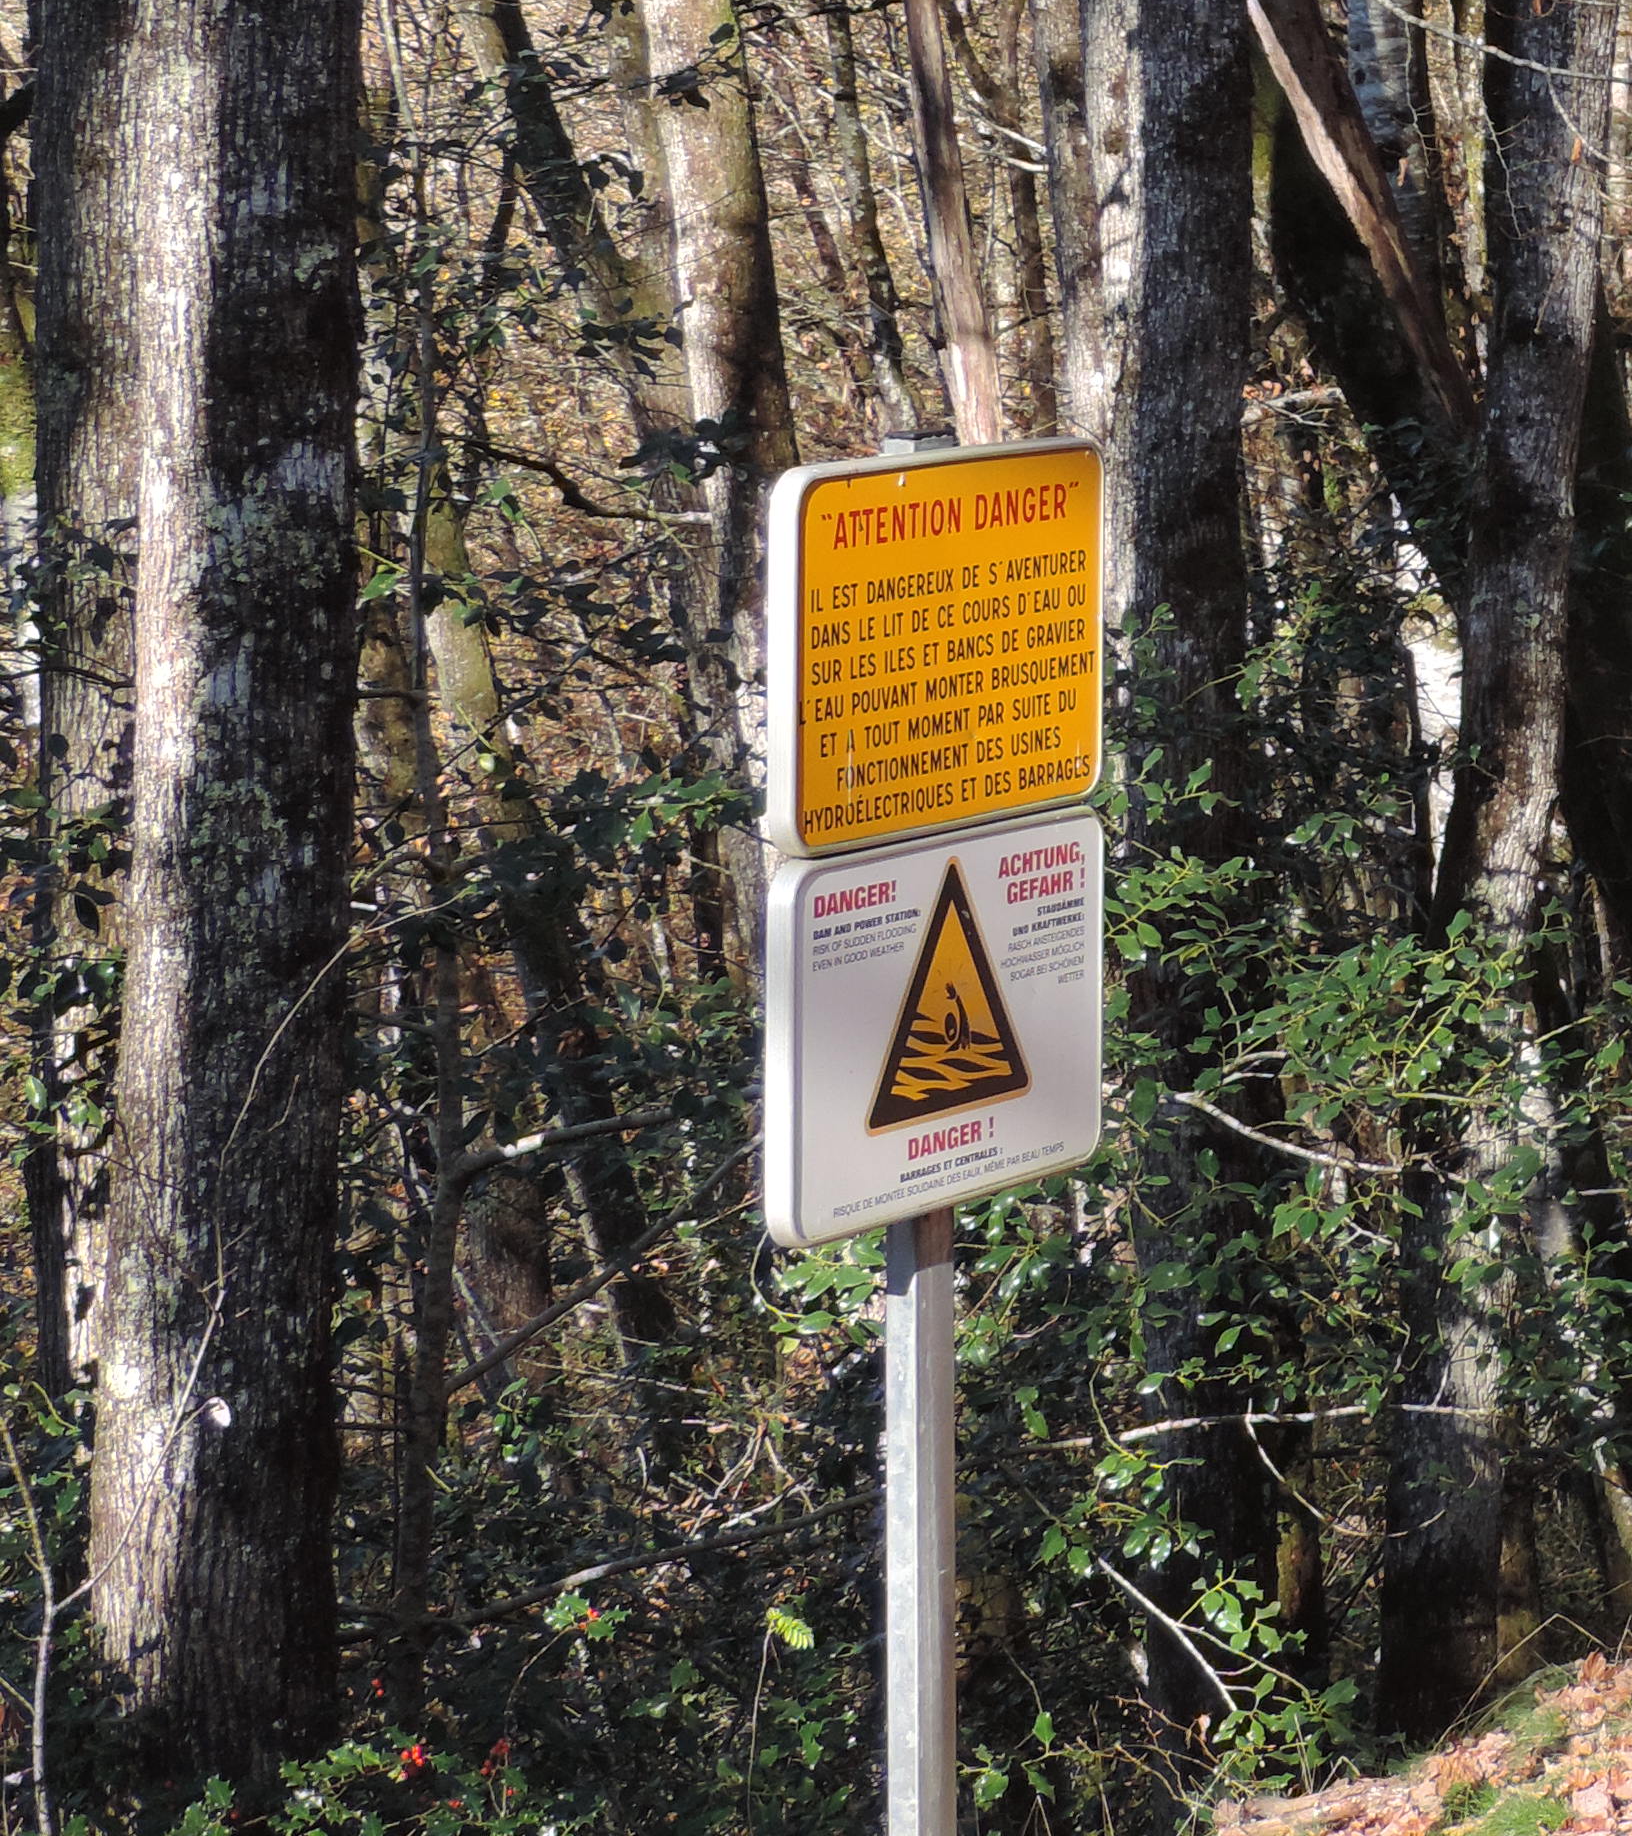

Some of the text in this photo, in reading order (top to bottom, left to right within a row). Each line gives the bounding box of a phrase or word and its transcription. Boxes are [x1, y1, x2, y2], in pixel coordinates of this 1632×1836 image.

[821, 481, 1079, 550] "ATTENTION DANGER"
[811, 588, 823, 613] IL
[833, 583, 858, 609] EST
[867, 569, 953, 604] DANGEREUX
[962, 565, 979, 589] DE
[811, 621, 850, 649] DANS
[860, 617, 875, 642] LE
[884, 612, 903, 637] LIT
[912, 608, 929, 633] DE
[938, 604, 954, 628] CE
[963, 595, 1010, 624] COURS
[1068, 584, 1086, 607] OU
[811, 618, 1085, 686] SUR LES ILES ET BANCS DE GRAVIER
[852, 682, 917, 716] POUVANT
[926, 670, 983, 702] MONTER
[992, 651, 1095, 690] BRUSQUEMENT
[821, 688, 1076, 757] ET A TOUT MOMENT PAR SUITE DU
[837, 726, 1061, 792] FONCTIONNEMENT DES USINES
[804, 755, 1090, 834] HYDROÉLECTRIQUES ET DES BARRAGES
[998, 841, 1085, 879] ACHTUNG,
[814, 880, 896, 918] DANGER!
[1007, 870, 1073, 904] GEFAHR
[813, 924, 916, 956] RISK OF SUDDEN FLOODING
[834, 924, 851, 935] AND
[854, 916, 882, 931] POWER
[1012, 925, 1029, 937] UND
[812, 942, 904, 972] EVEN IN GOOD WEATHER
[908, 1120, 982, 1161] DANGER
[833, 1201, 861, 1219] RISQUE
[863, 1198, 873, 1210] DE
[947, 1172, 961, 1185] DES
[1006, 1156, 1020, 1168] PAR
[1042, 1141, 1065, 1156] TEMPS
[900, 1162, 941, 1183] BARRAGES
[944, 1158, 952, 1171] ET
